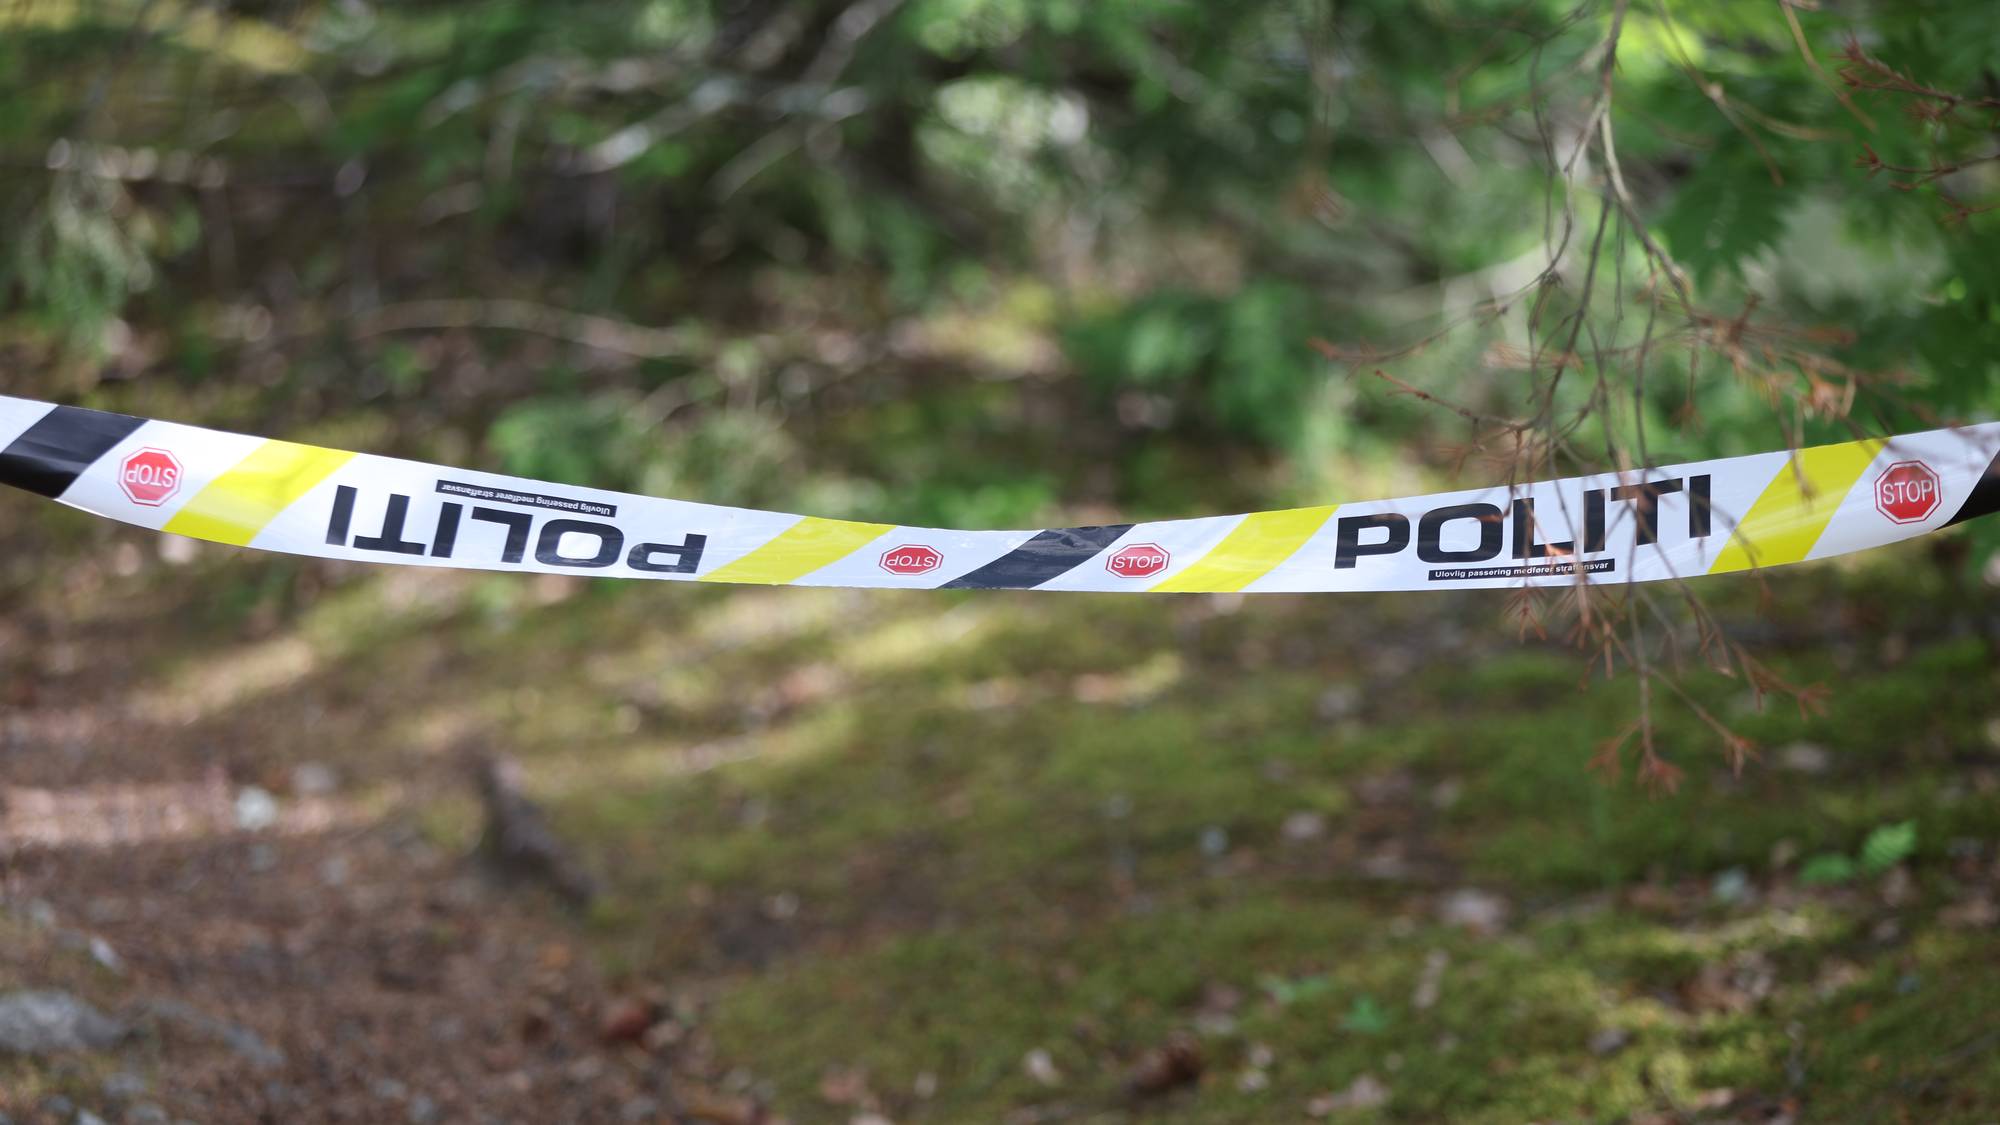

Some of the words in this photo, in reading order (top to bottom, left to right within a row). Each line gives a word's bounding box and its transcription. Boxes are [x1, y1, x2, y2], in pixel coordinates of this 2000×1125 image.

[126, 463, 176, 488] STOP
[442, 484, 495, 498] straffansvar
[1883, 480, 1933, 505] STOP
[536, 496, 579, 510] passering
[580, 503, 610, 515] Ulovlig
[326, 484, 707, 574] POLITI
[1334, 474, 1711, 569] POLITI
[887, 553, 935, 567] STOP
[1114, 555, 1163, 569] STOP
[1435, 570, 1466, 579] Ulovlig
[1468, 568, 1511, 577] passering
[1555, 562, 1609, 573] straffnsvar
